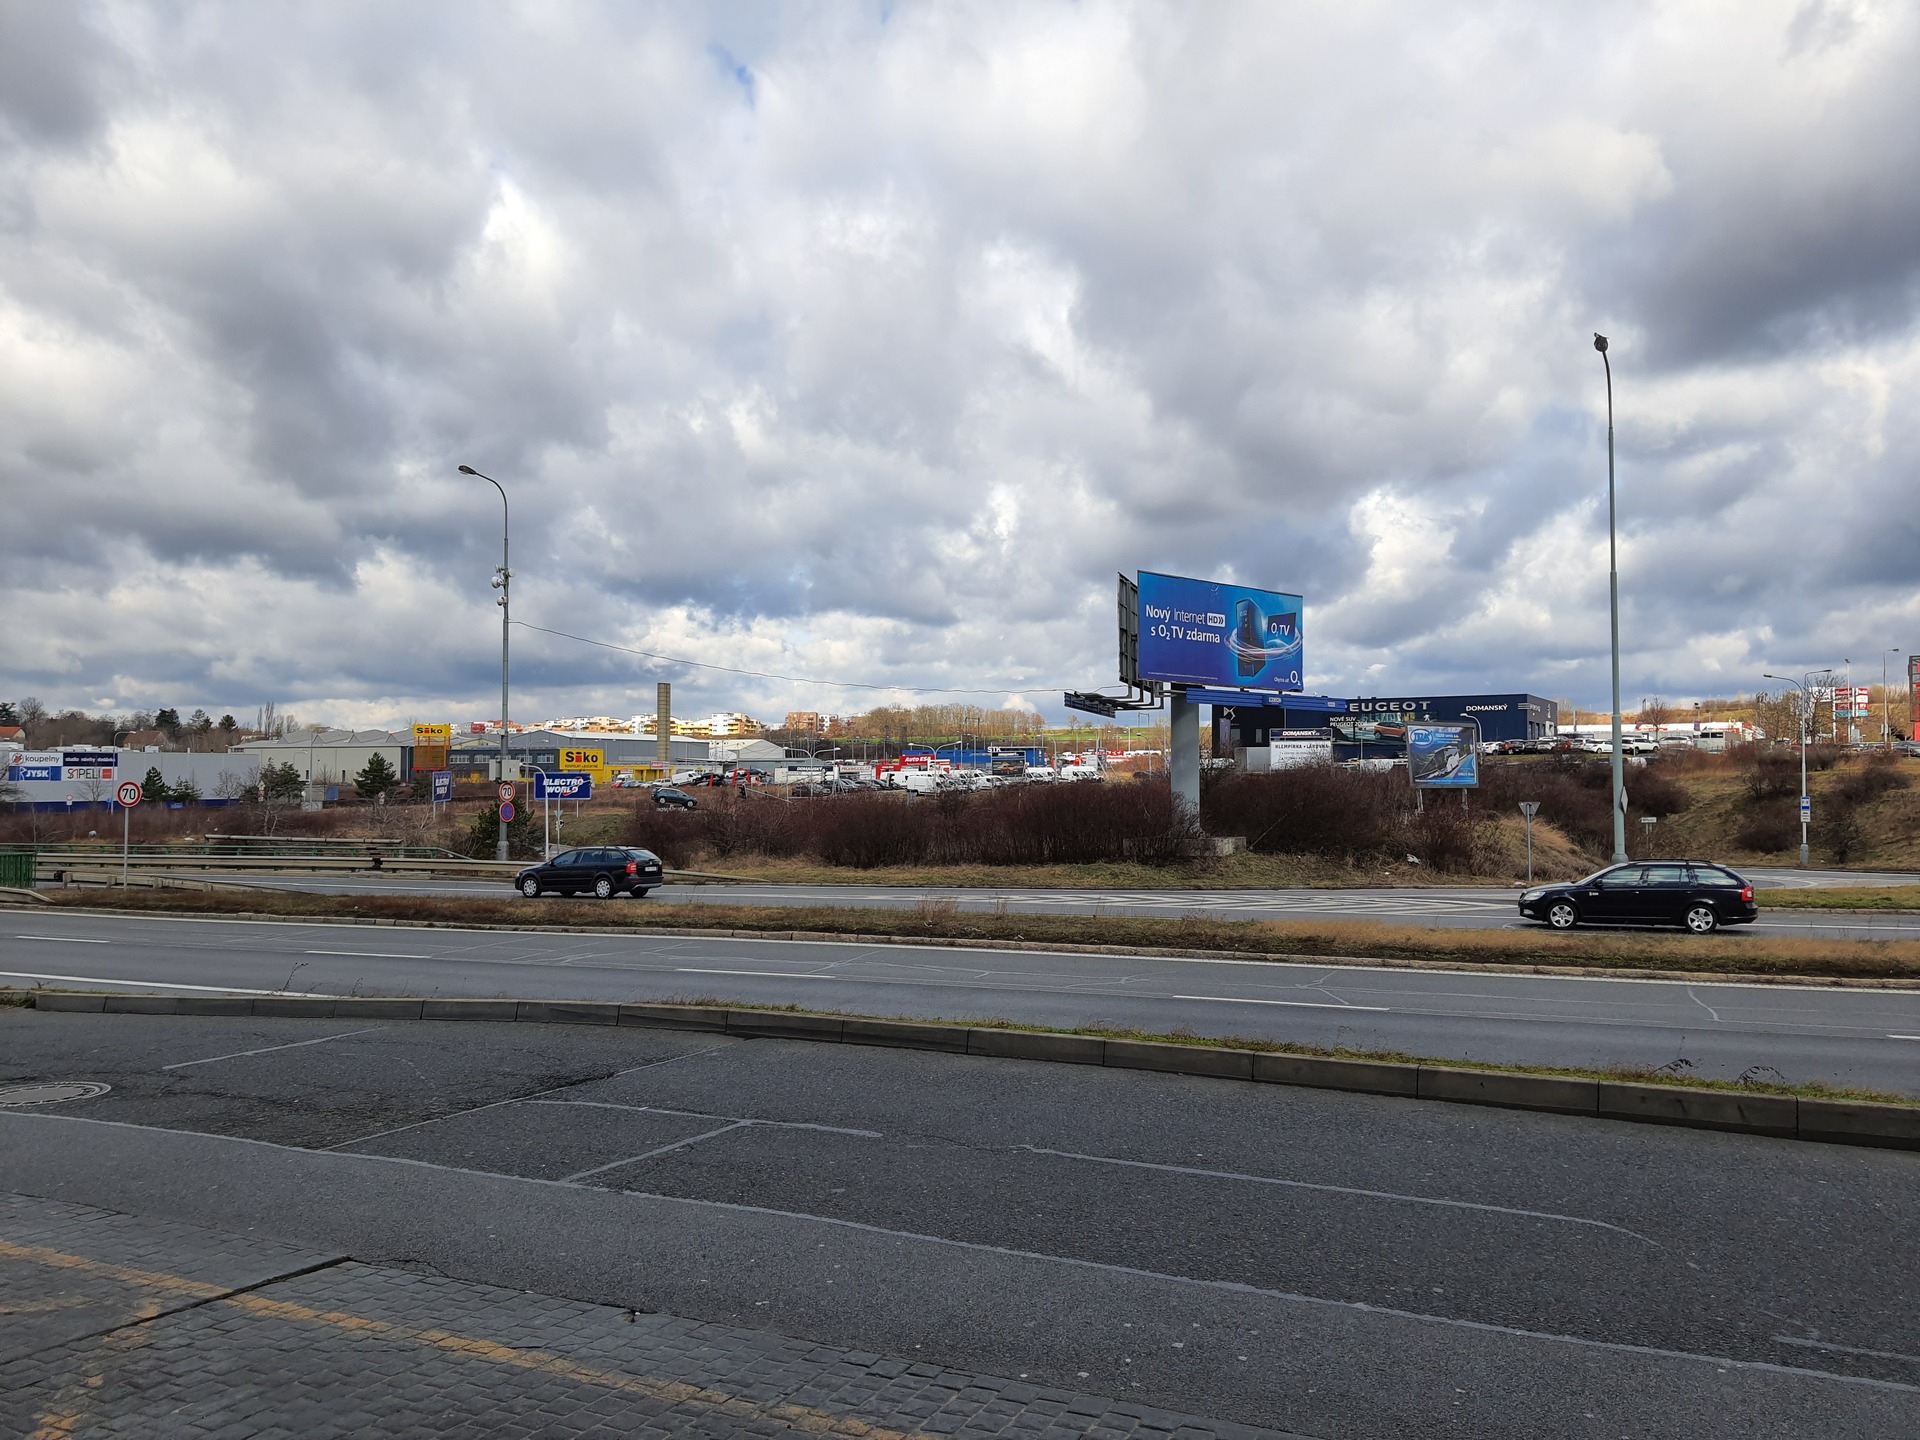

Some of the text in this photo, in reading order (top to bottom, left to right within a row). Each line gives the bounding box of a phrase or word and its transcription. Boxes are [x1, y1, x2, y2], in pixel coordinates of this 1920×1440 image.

[1145, 604, 1171, 623] Nový
[1173, 607, 1206, 625] Internet
[1150, 626, 1156, 636] s
[1170, 625, 1184, 639] TV
[1186, 627, 1221, 643] zdarma
[1279, 624, 1290, 636] TV
[1345, 701, 1431, 713] EUGEOT
[1465, 703, 1508, 712] DOMANSKÝ
[25, 755, 60, 763] koupelny
[25, 769, 49, 778] JYSK
[542, 778, 584, 786] ELECTRO
[122, 788, 136, 800] 70
[503, 787, 512, 797] 70
[546, 785, 579, 793] WORLD
